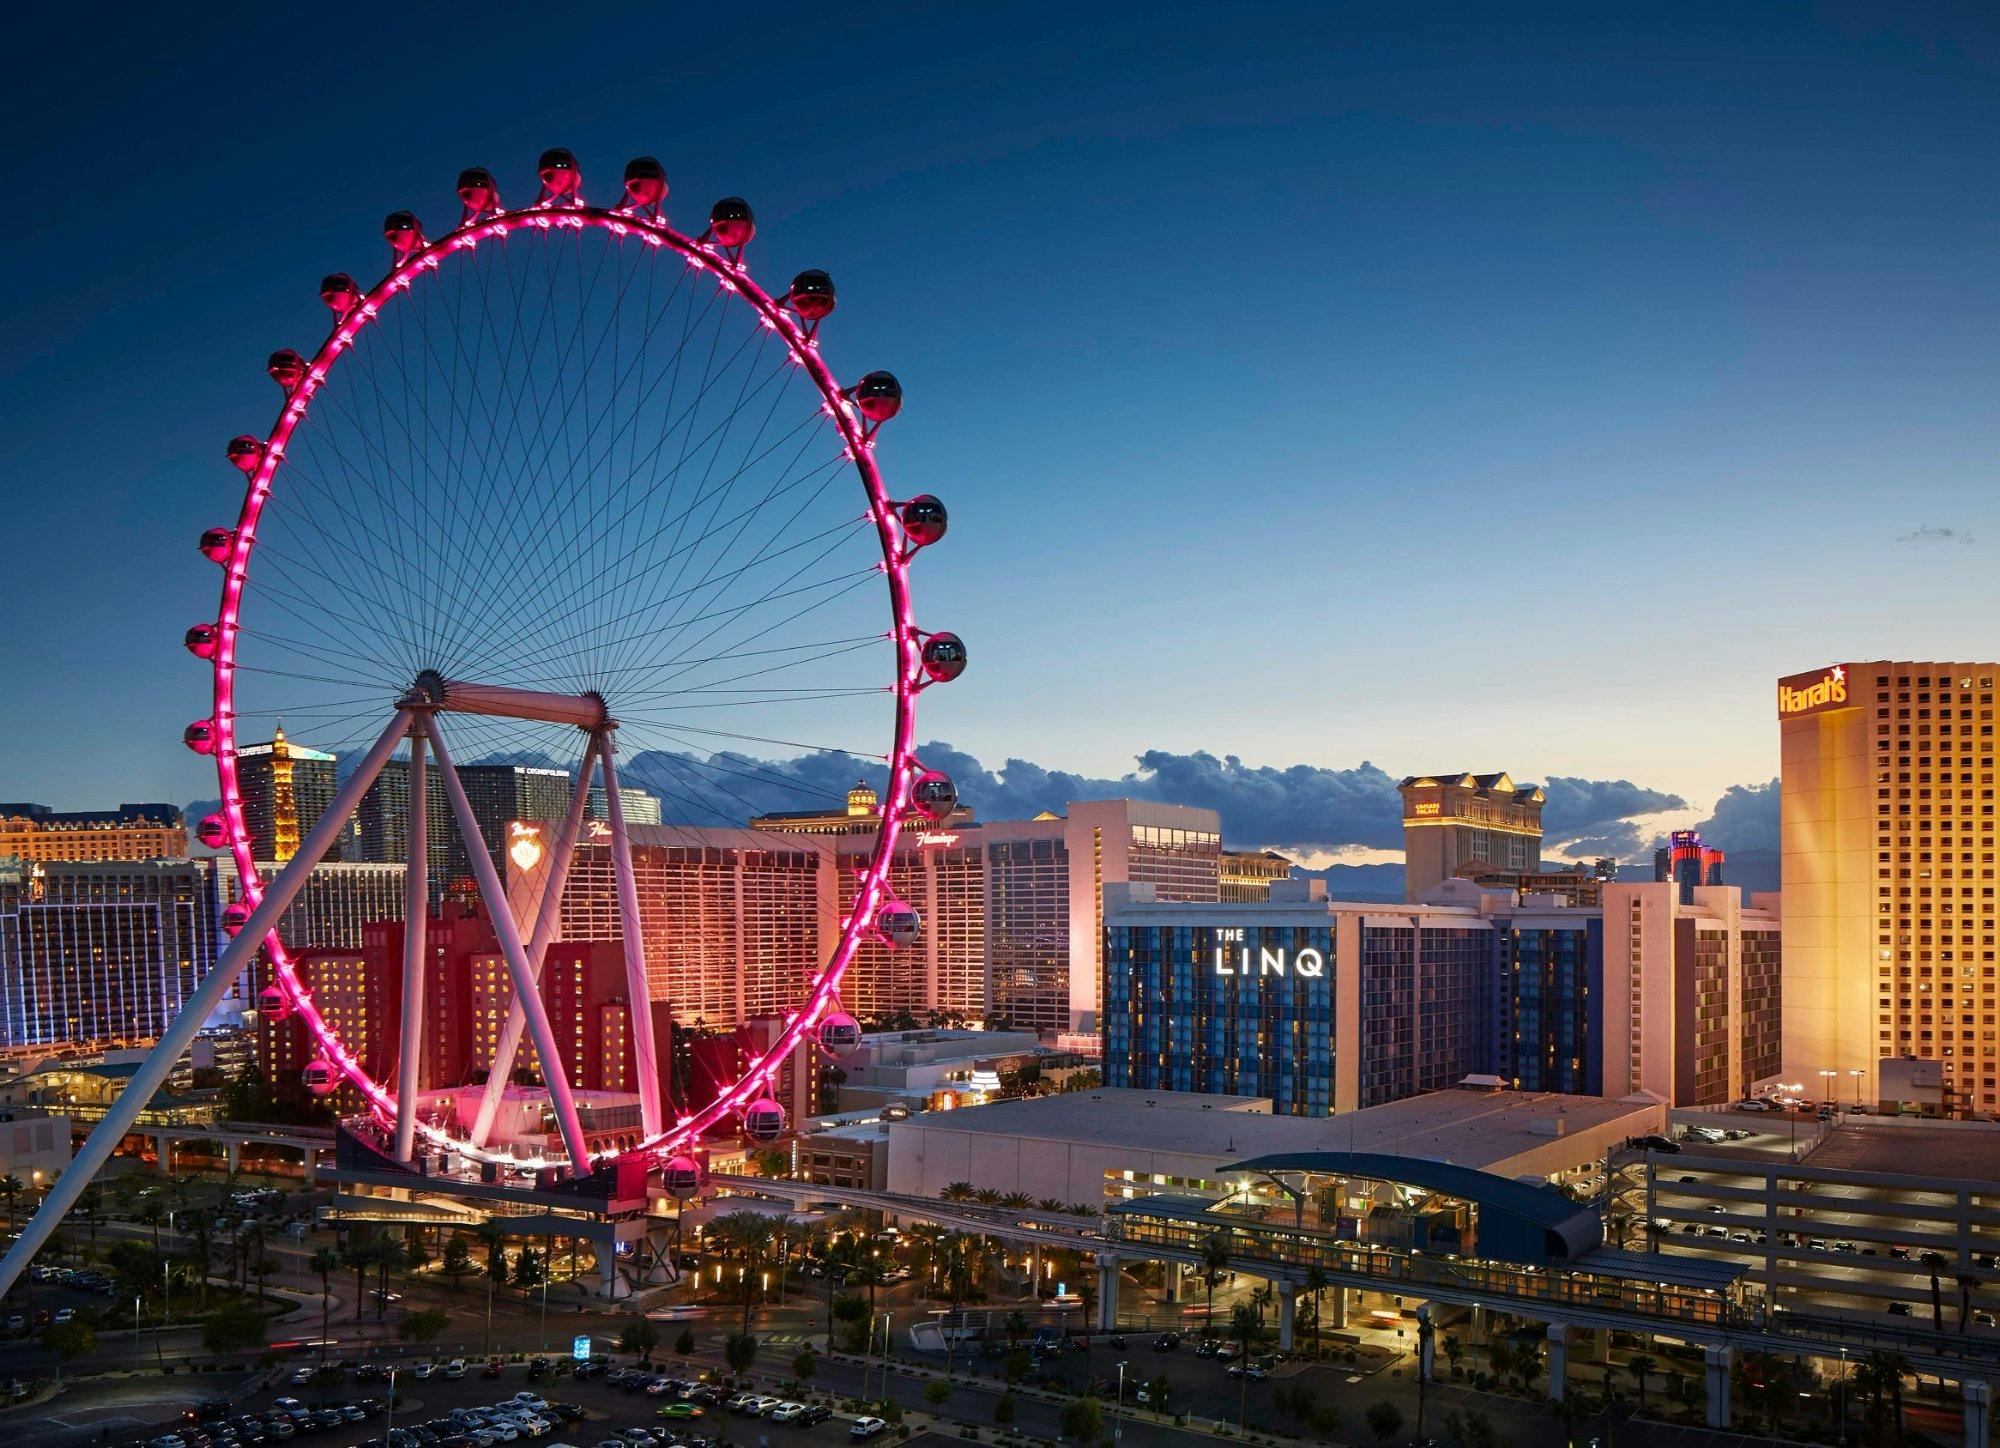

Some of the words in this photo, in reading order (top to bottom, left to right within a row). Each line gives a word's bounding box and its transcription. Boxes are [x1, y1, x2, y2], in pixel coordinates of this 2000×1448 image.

[915, 831, 960, 848] Flamingo
[1216, 929, 1244, 941] THE
[1216, 947, 1323, 977] LINQ
